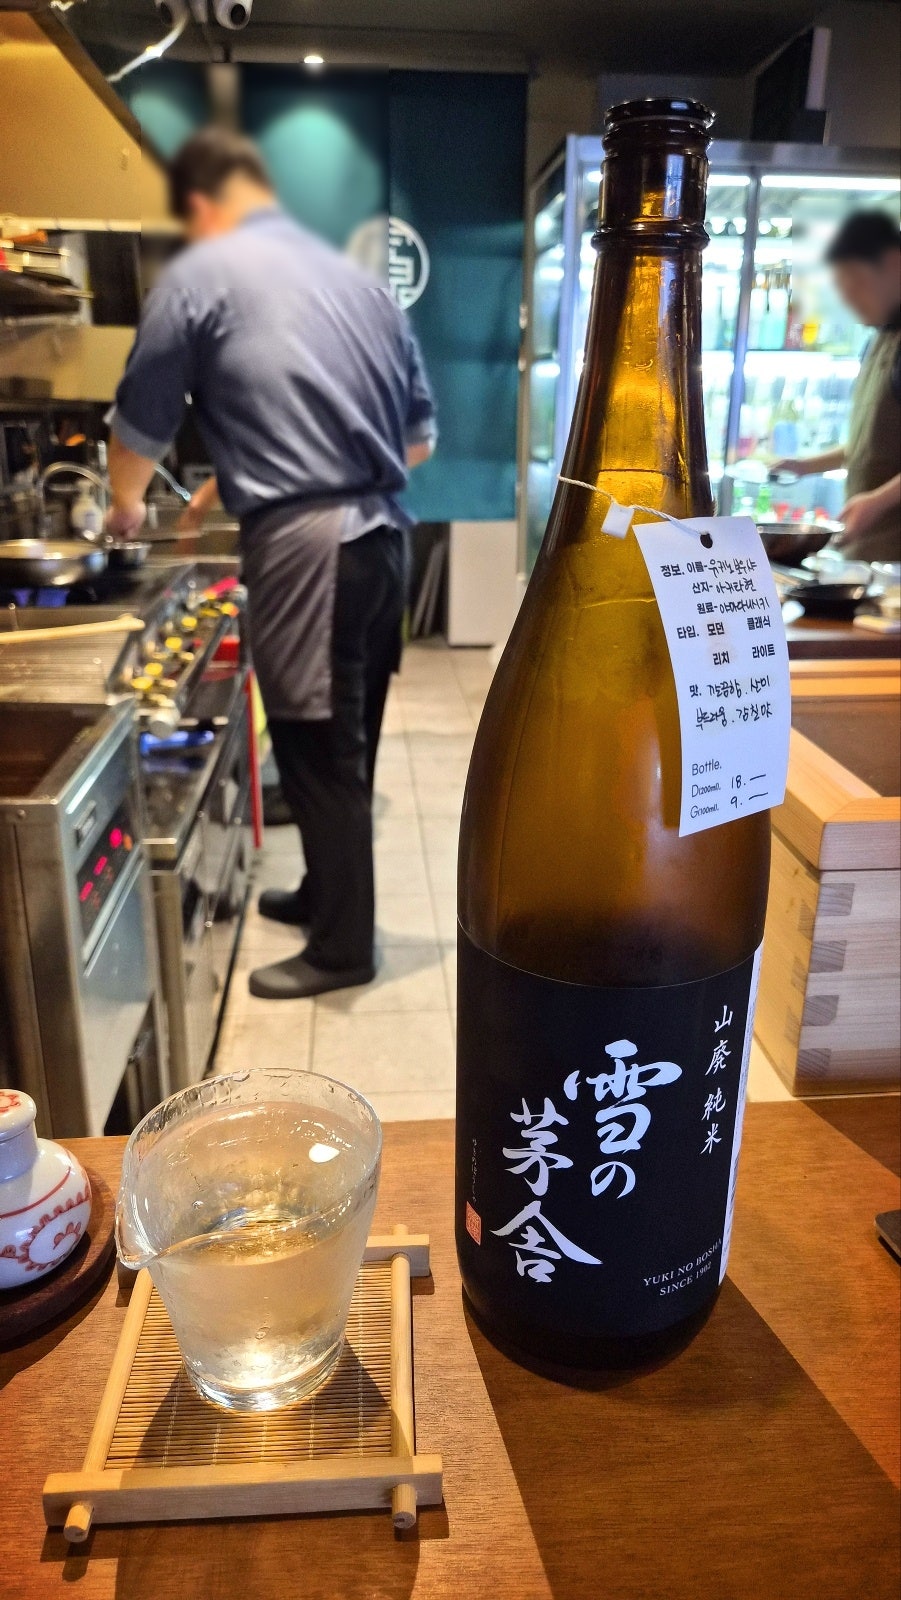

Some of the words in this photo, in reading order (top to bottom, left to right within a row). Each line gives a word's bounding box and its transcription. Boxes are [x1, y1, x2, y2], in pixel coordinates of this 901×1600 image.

[660, 564, 685, 578] 정보.
[676, 625, 700, 640] 타입.
[706, 621, 725, 636] 모던
[746, 615, 771, 631] 클래식
[712, 651, 730, 666] 리치
[751, 643, 776, 659] 라이트
[689, 684, 702, 698] 맛.
[691, 758, 722, 776] Bottle.
[643, 1270, 675, 1287] YUKI
[677, 1262, 694, 1276] NO
[695, 1237, 722, 1266] BOSHA
[659, 1275, 693, 1296] SINCE
[696, 1261, 712, 1279] 1902
